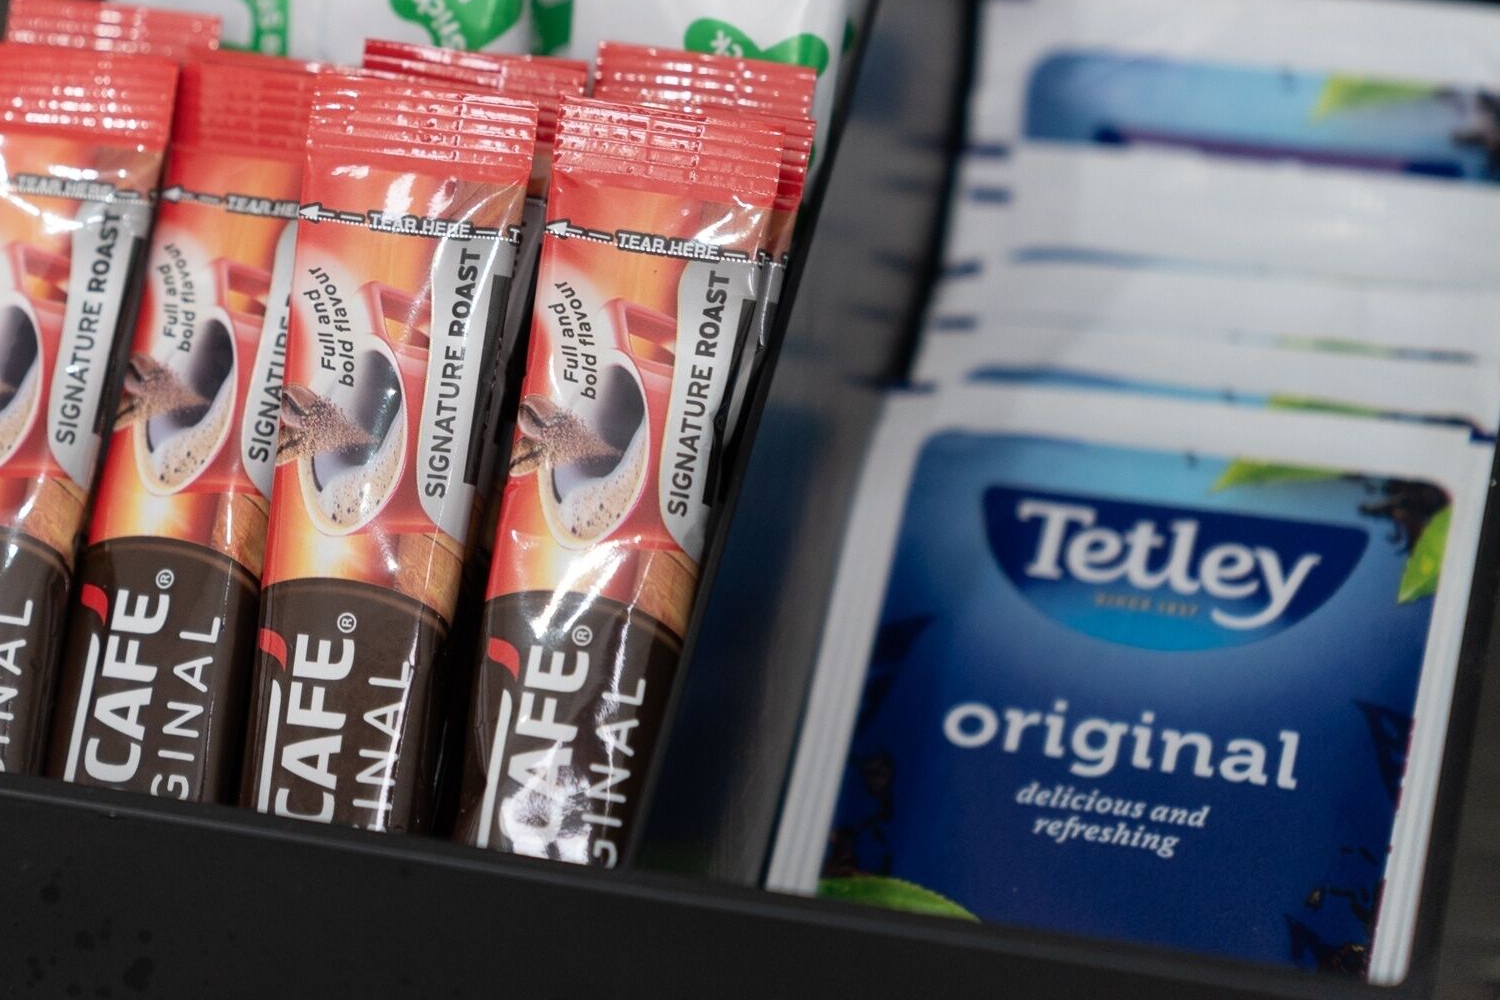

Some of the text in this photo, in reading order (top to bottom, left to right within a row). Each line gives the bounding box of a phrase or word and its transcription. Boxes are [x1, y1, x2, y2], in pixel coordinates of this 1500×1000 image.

[369, 213, 471, 238] TEAR HERE
[618, 232, 719, 259] TEAR HERE
[56, 210, 120, 445] SIGNATURE ROAST
[158, 264, 178, 337] Full and
[164, 244, 196, 352] bold flavour
[303, 288, 336, 371] Full and
[308, 267, 354, 387] bold flavour
[548, 302, 579, 384] Full and
[554, 282, 597, 400] bold flavour
[425, 248, 481, 499] SIGNATURE ROAST
[667, 270, 730, 517] SIGNATURE ROAST
[1016, 497, 1321, 631] Tetley
[352, 662, 412, 832] INAL
[942, 699, 1300, 790] original
[1016, 781, 1211, 828] delicious and
[1032, 816, 1180, 858] refreshing
